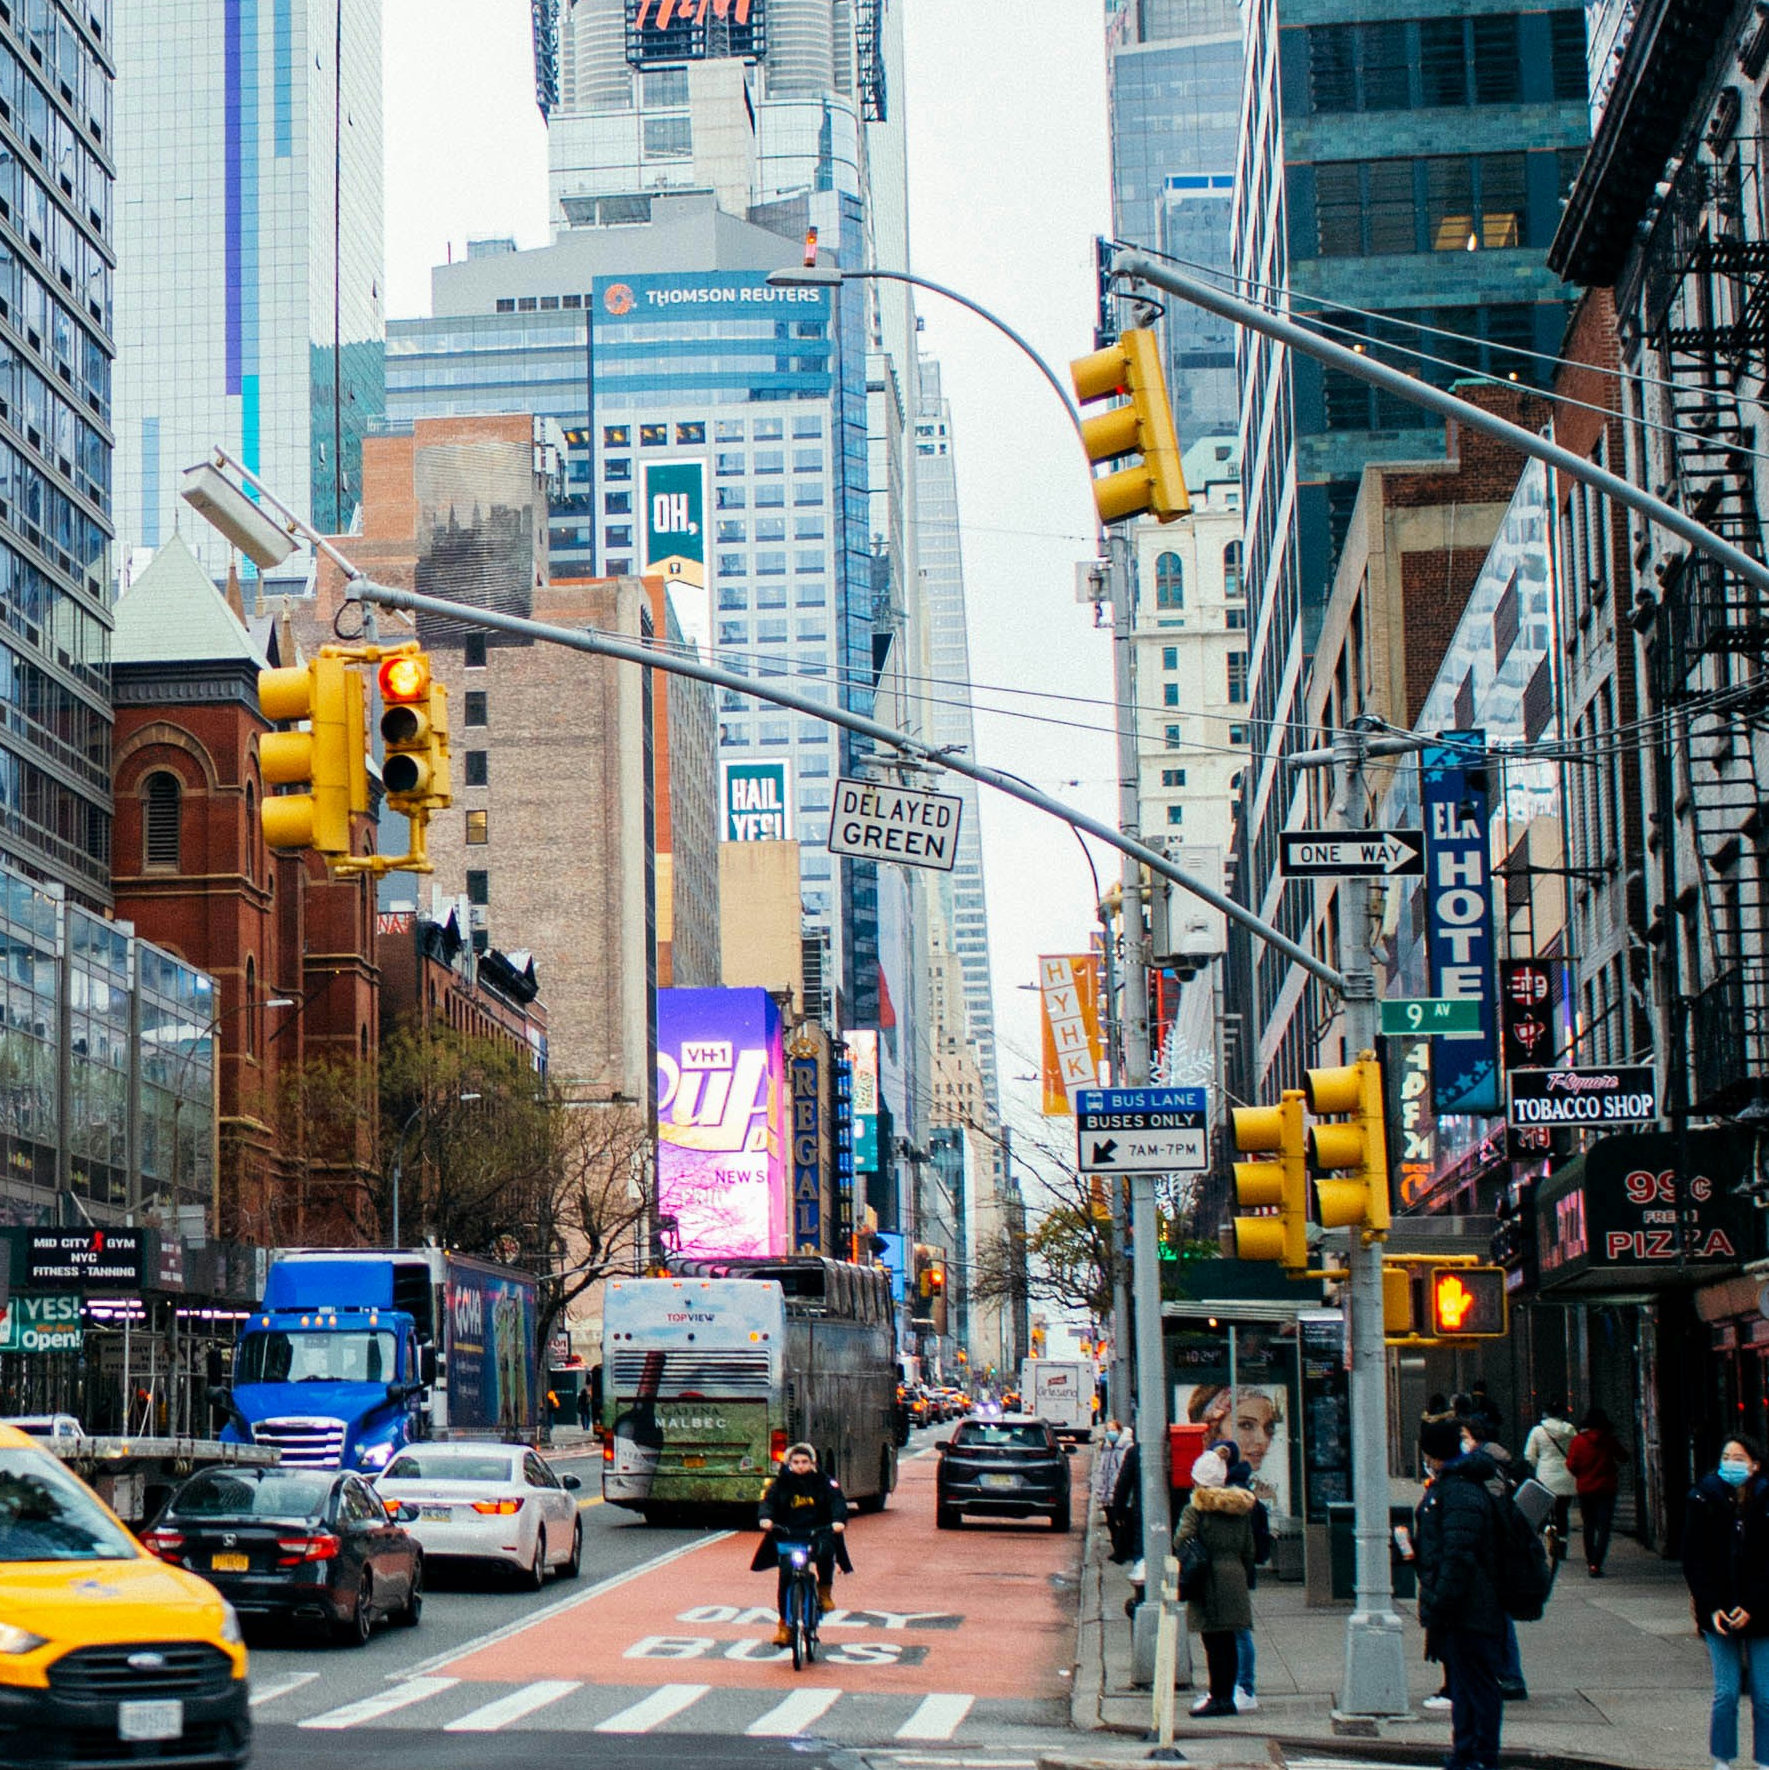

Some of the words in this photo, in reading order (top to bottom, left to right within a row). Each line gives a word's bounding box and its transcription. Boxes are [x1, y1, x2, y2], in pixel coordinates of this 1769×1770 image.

[645, 287, 737, 305] THOMSON
[739, 286, 821, 304] REUTERS
[652, 492, 698, 535] OH,
[730, 777, 782, 812] HAIL
[842, 793, 952, 830] DELAYED
[841, 821, 948, 861] GREEN
[1299, 844, 1341, 863] ONE
[1360, 844, 1402, 862] WAY
[1436, 850, 1487, 1040] HOTE
[1406, 1003, 1424, 1030] 9
[1433, 1003, 1451, 1017] AV
[1111, 1094, 1145, 1107] BUS
[1150, 1092, 1197, 1106] LANE
[1514, 1096, 1600, 1122] TOBACCO
[1603, 1093, 1654, 1119] SHOP
[1086, 1113, 1144, 1129] BUSES
[1150, 1113, 1196, 1127] ONLY
[794, 1066, 821, 1236] REGAL
[1128, 1142, 1197, 1157] 7AM-7PM
[714, 1170, 751, 1184] NEW
[33, 1237, 58, 1249] MID
[61, 1237, 90, 1249] CITY
[106, 1237, 136, 1249] GYM
[70, 1252, 98, 1264] NYC
[33, 1266, 79, 1278] FITNESS
[25, 1296, 81, 1321] YES!
[455, 1286, 482, 1337] GOYA
[22, 1329, 81, 1352] Open!
[654, 1417, 727, 1429] MALBEC
[621, 1635, 904, 1666] BUS
